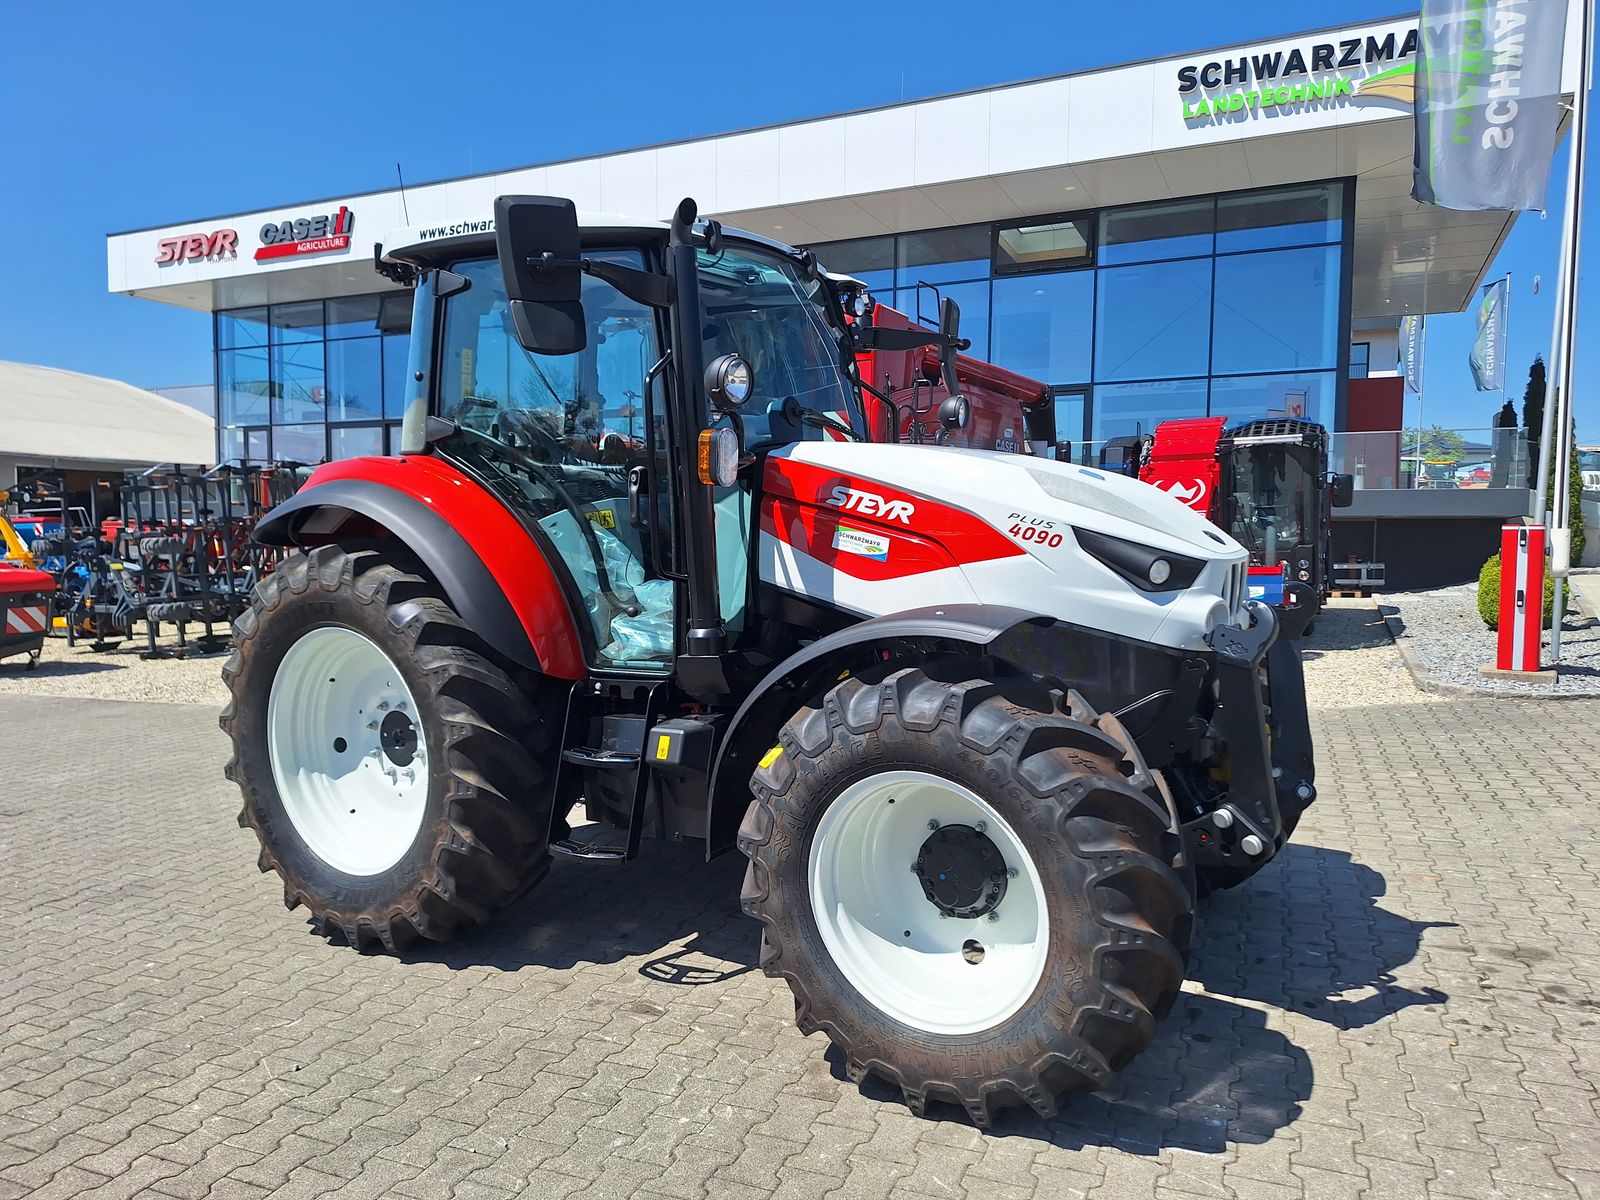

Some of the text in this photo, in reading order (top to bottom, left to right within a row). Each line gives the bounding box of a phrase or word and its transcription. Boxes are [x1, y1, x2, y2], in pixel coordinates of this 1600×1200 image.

[1182, 76, 1351, 119] LANDTECHNIK
[419, 219, 497, 241] www.schwar
[154, 229, 238, 263] STEYR
[297, 237, 345, 252] AGRICULTURE
[995, 438, 1014, 453] CASE
[825, 485, 915, 525] STEYR
[1007, 512, 1057, 529] PLUS
[839, 531, 881, 547] SCHWARZMAYR
[1008, 523, 1063, 548] 4090
